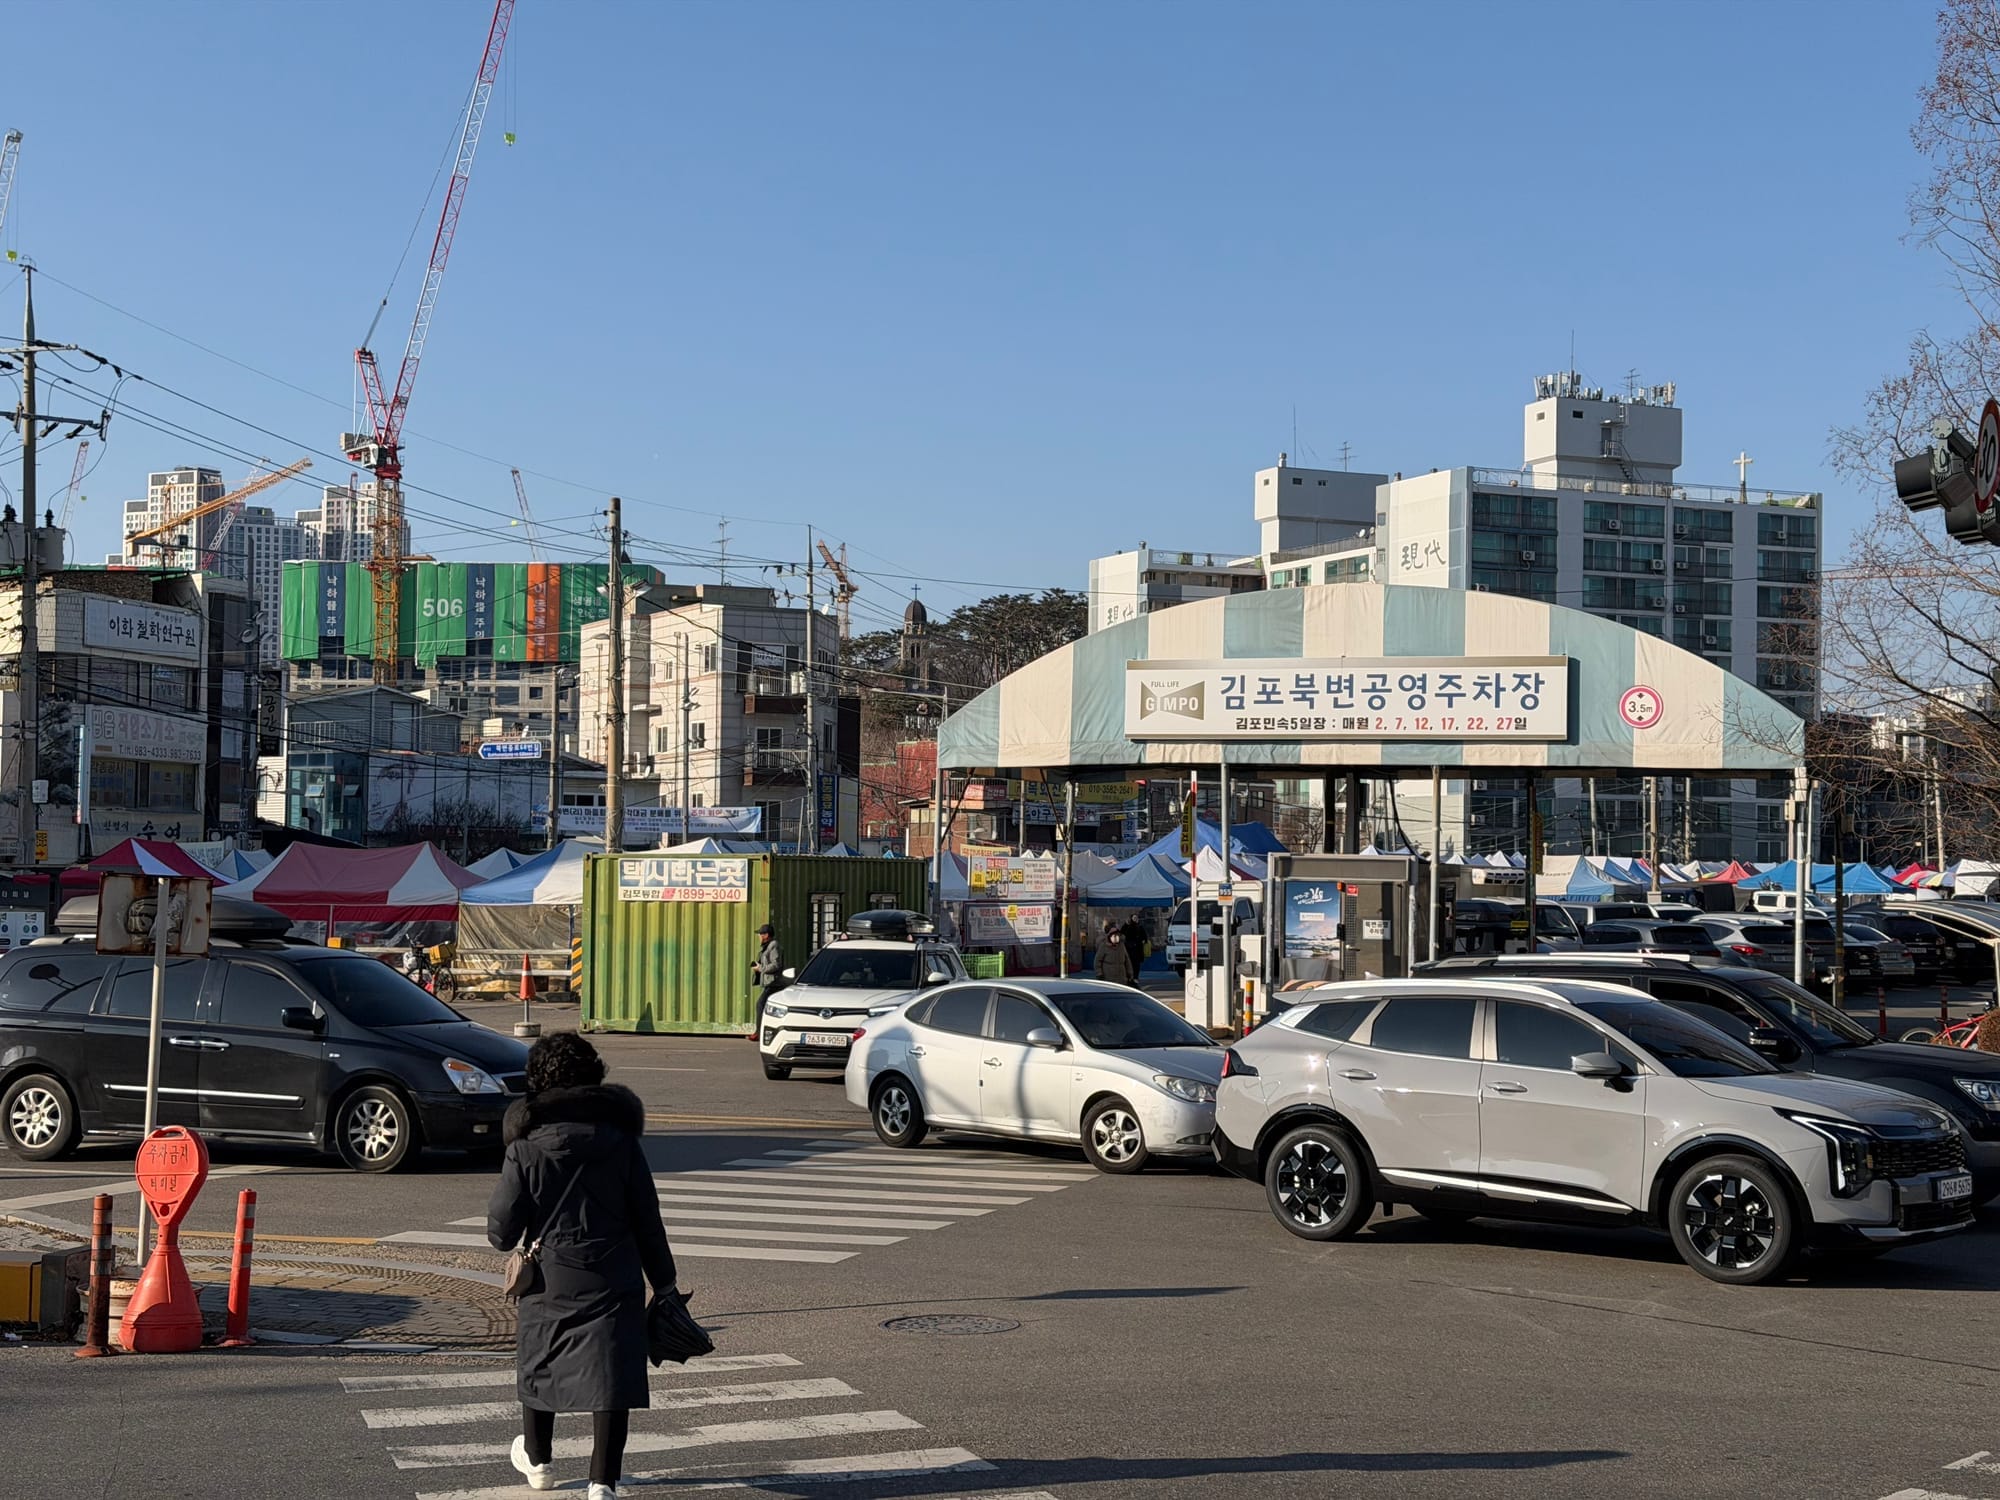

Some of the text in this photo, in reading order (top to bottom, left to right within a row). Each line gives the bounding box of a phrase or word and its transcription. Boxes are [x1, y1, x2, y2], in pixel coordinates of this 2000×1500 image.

[1401, 539, 1446, 570] 現代
[422, 598, 463, 618] 506
[109, 615, 196, 647] 이화 철학연구원
[498, 644, 506, 655] 4
[1221, 673, 1545, 711] 김포북변공영주차장
[1628, 700, 1653, 713] 3.5m
[1235, 717, 1326, 730] 김포민속5일장
[1342, 717, 1369, 730] 매월
[1414, 717, 1433, 730] 12,
[1441, 717, 1459, 730] 17,
[1467, 717, 1489, 730] 22,
[1496, 717, 1528, 730] 27일
[623, 860, 745, 886] 택시타는곳
[677, 888, 741, 900] 1899-3040
